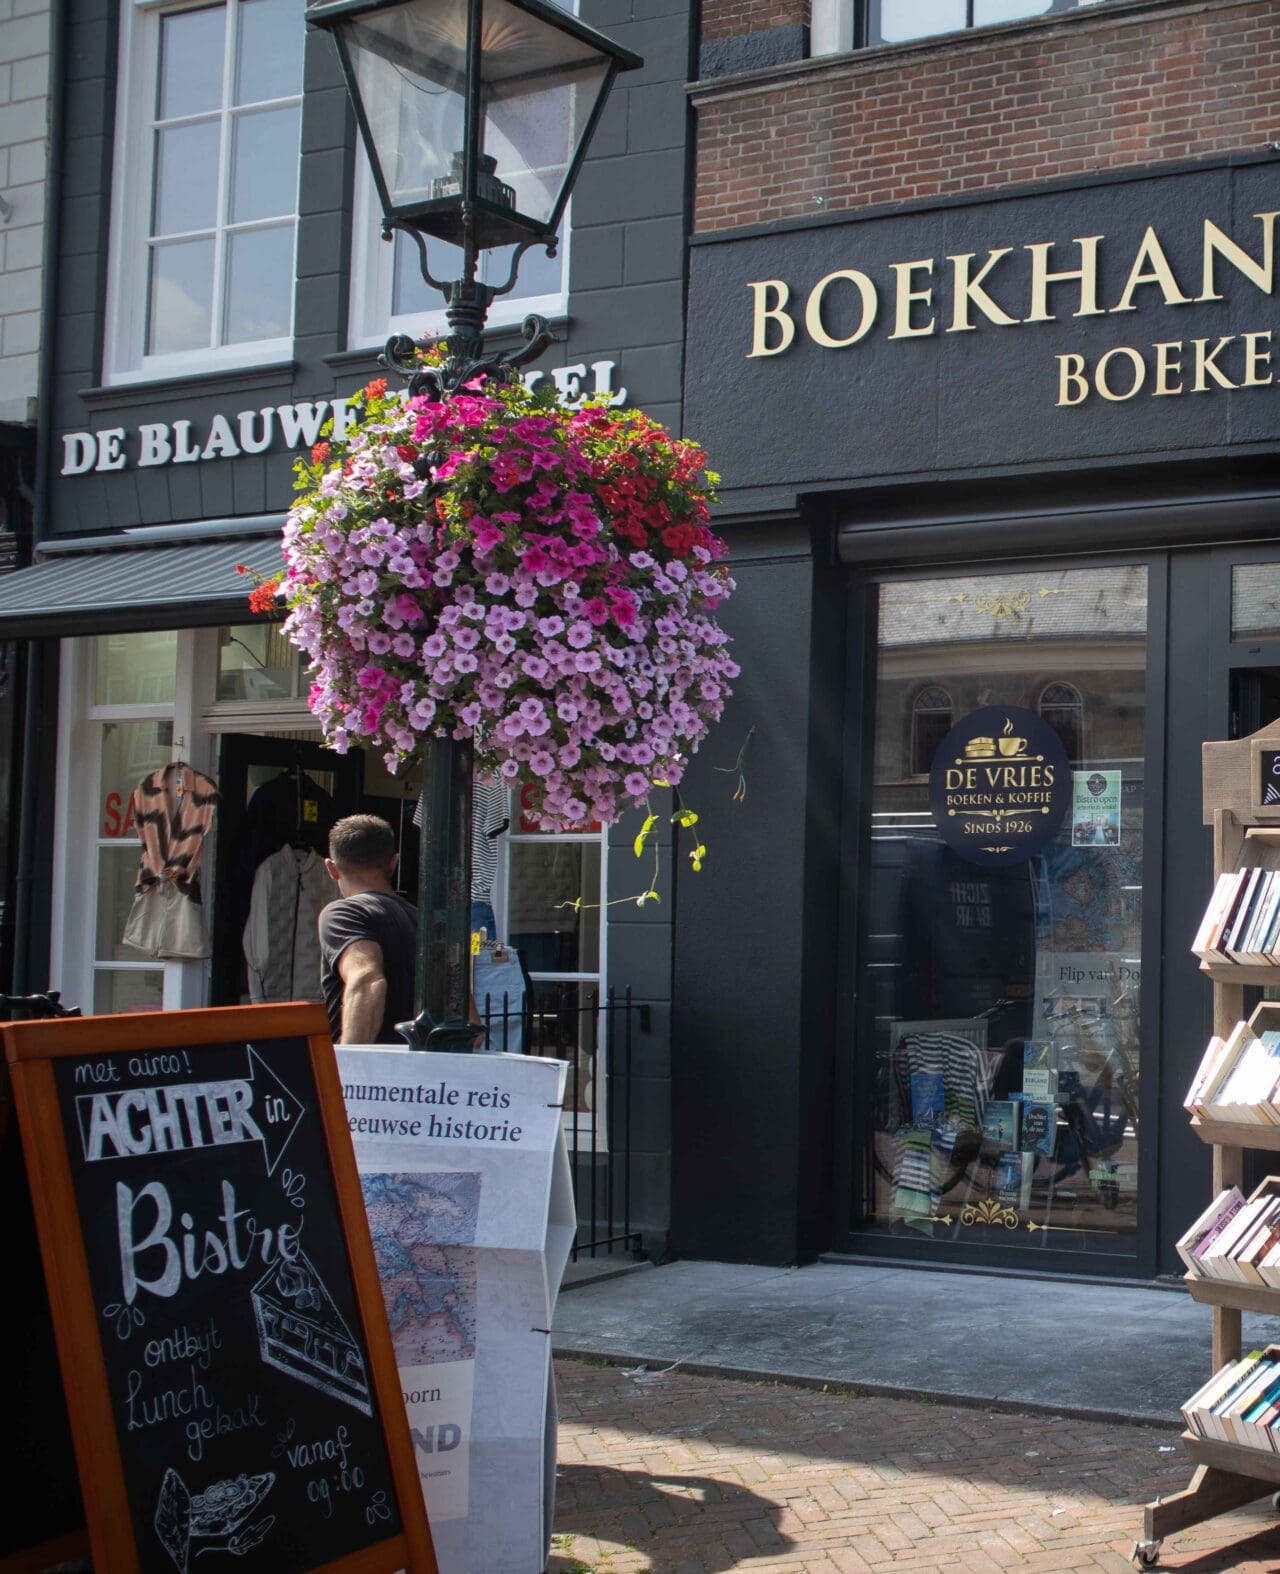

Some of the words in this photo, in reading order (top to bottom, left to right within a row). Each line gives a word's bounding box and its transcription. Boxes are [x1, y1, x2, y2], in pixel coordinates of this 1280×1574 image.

[60, 427, 127, 475] DE
[945, 768, 977, 790] DE
[984, 765, 1055, 788] VRIES
[103, 791, 139, 838] SA
[947, 793, 992, 805] BOEKEN
[995, 793, 1005, 804] &
[1008, 792, 1052, 803] KOFFIE
[964, 822, 1001, 834] SINDS
[1005, 820, 1033, 833] 1926
[1059, 967, 1085, 985] Flip
[75, 1058, 121, 1085] met
[128, 1051, 193, 1077] airco!
[344, 1081, 460, 1106] numentale
[466, 1086, 511, 1109] reis
[86, 1079, 264, 1160] ACHTER
[264, 1094, 291, 1125] in
[348, 1116, 422, 1137] eeuwse
[427, 1114, 522, 1142] historie
[116, 1179, 305, 1305] Bistro
[126, 1364, 213, 1431] Lunch
[185, 1394, 267, 1462] gebak
[411, 1423, 461, 1454] ND
[287, 1425, 352, 1469] vanaf
